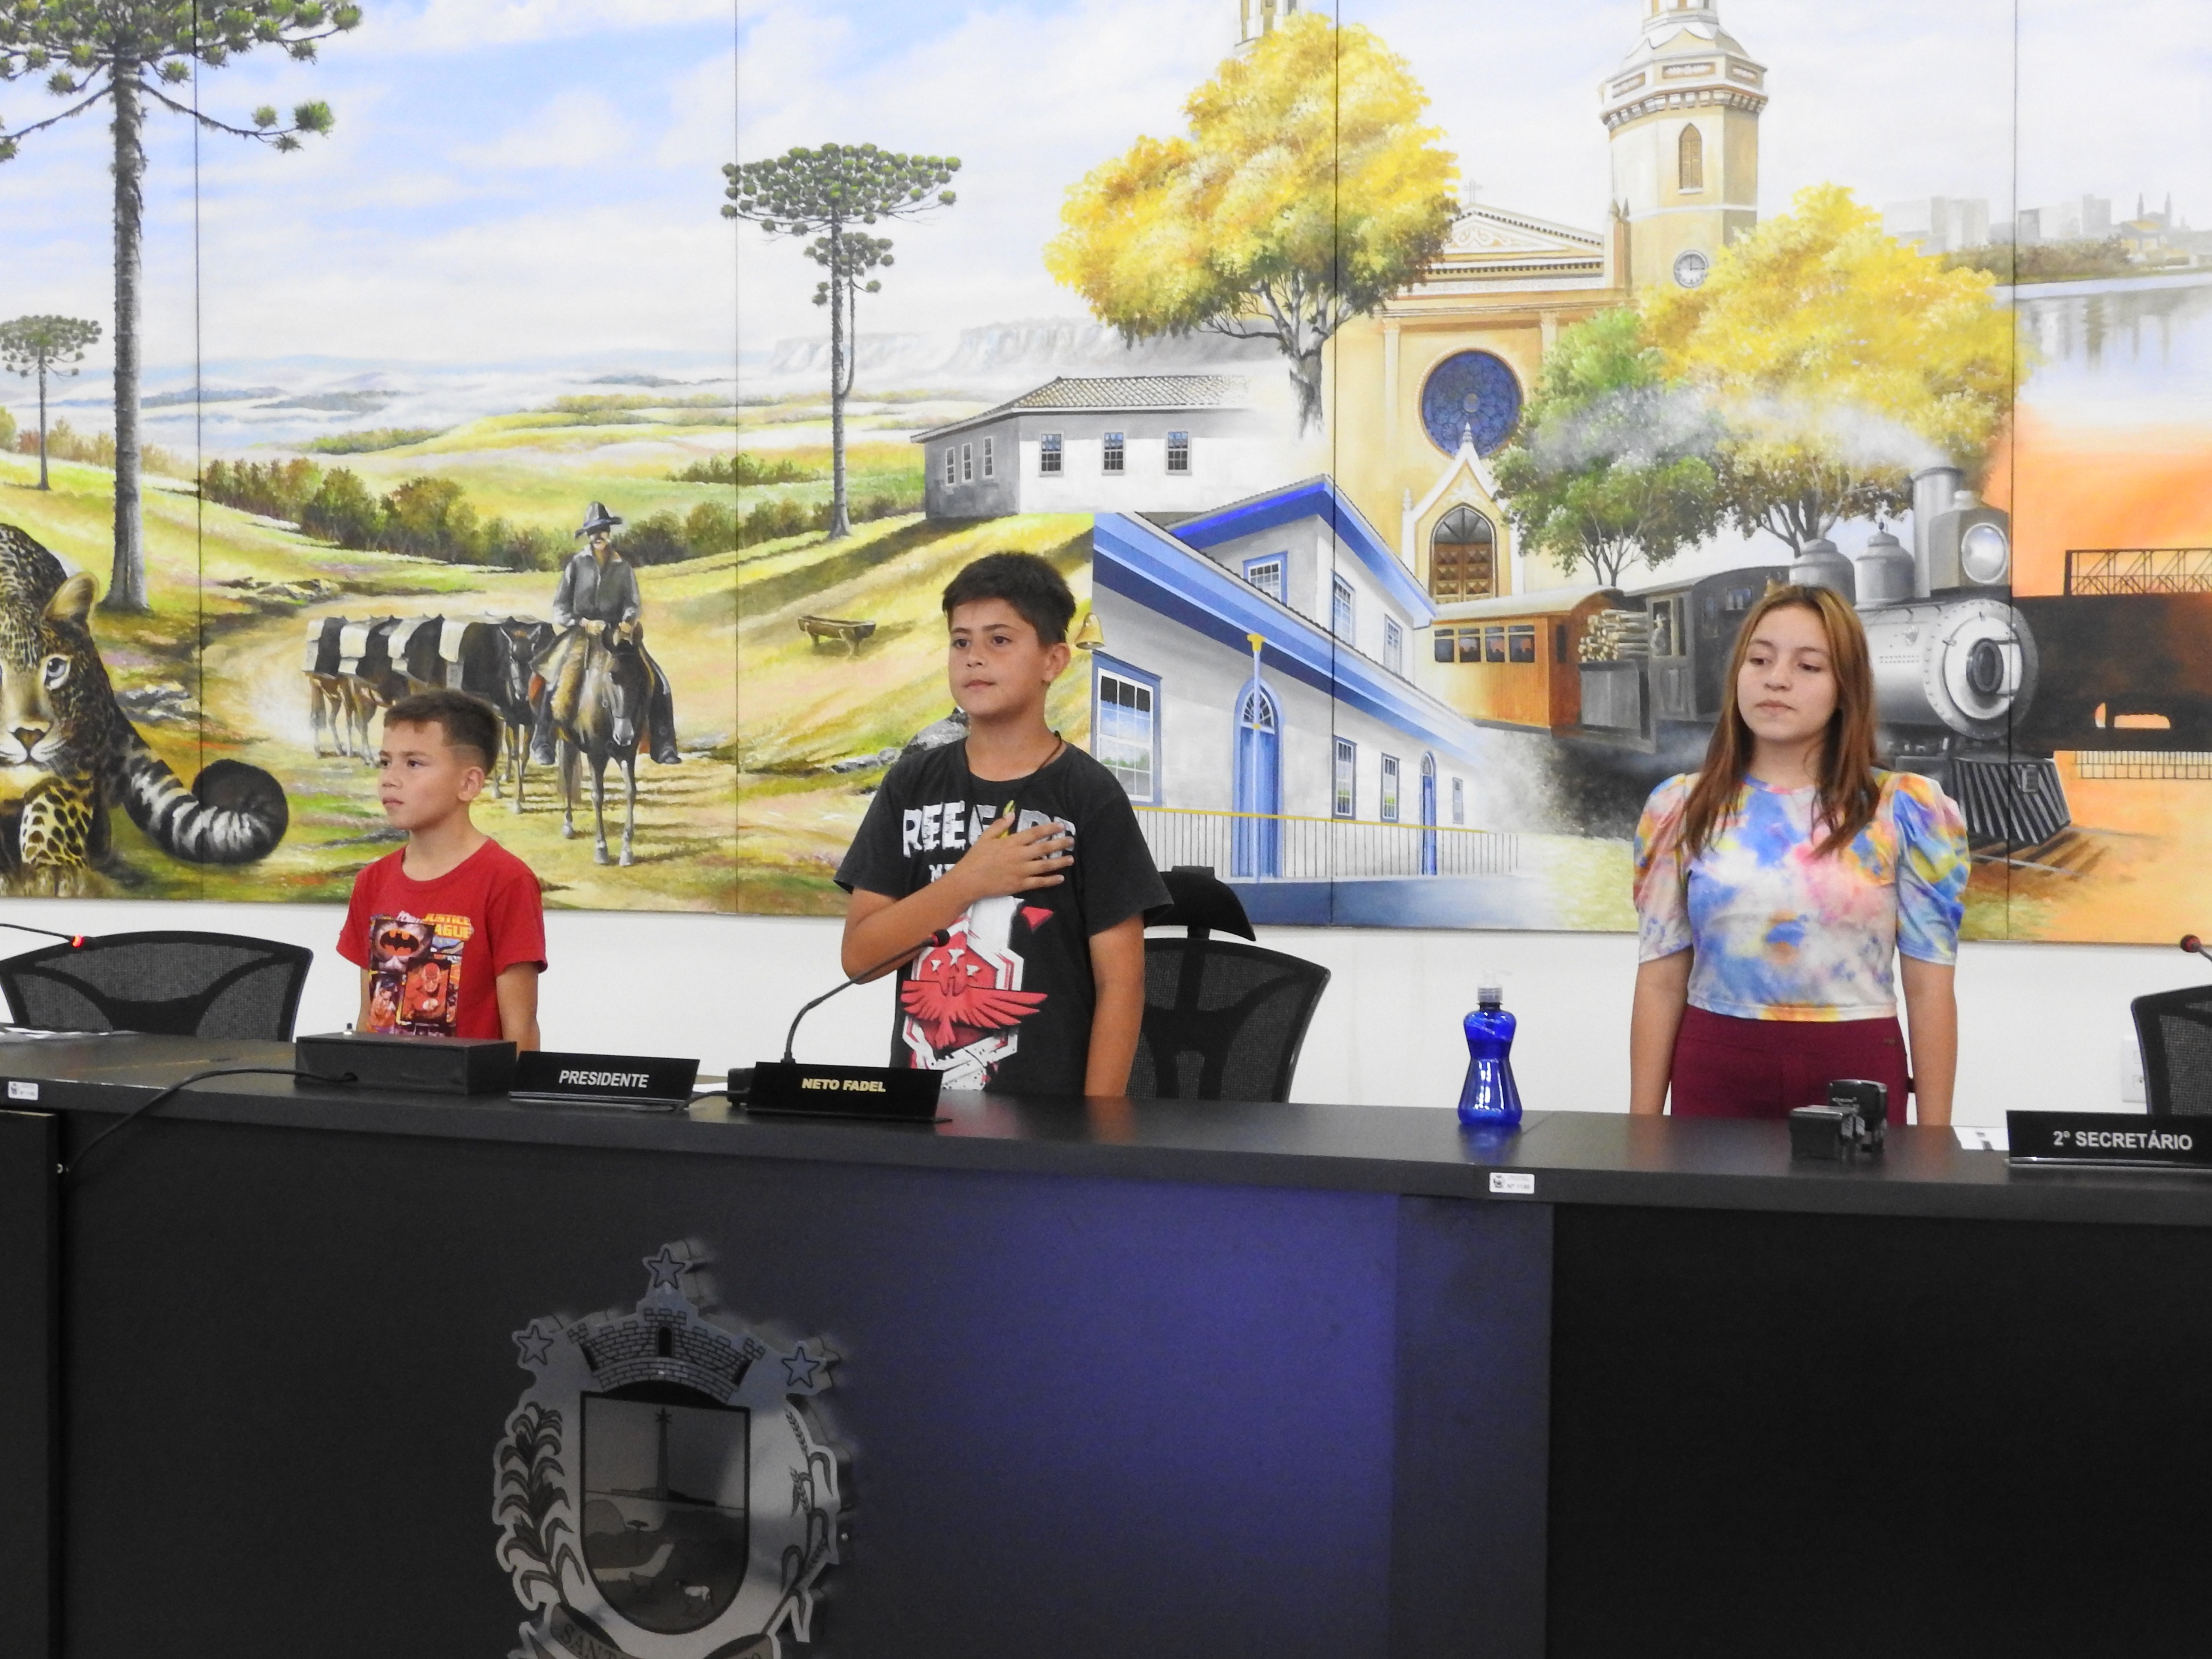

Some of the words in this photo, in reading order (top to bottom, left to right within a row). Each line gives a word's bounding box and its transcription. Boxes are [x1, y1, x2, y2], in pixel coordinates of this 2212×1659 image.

[434, 923, 471, 939] AGUE
[559, 1070, 650, 1088] PRESIDENTE
[802, 1078, 840, 1090] NETO
[843, 1080, 886, 1092] FADEL
[2075, 1129, 2193, 1150] SECRETÁRIO
